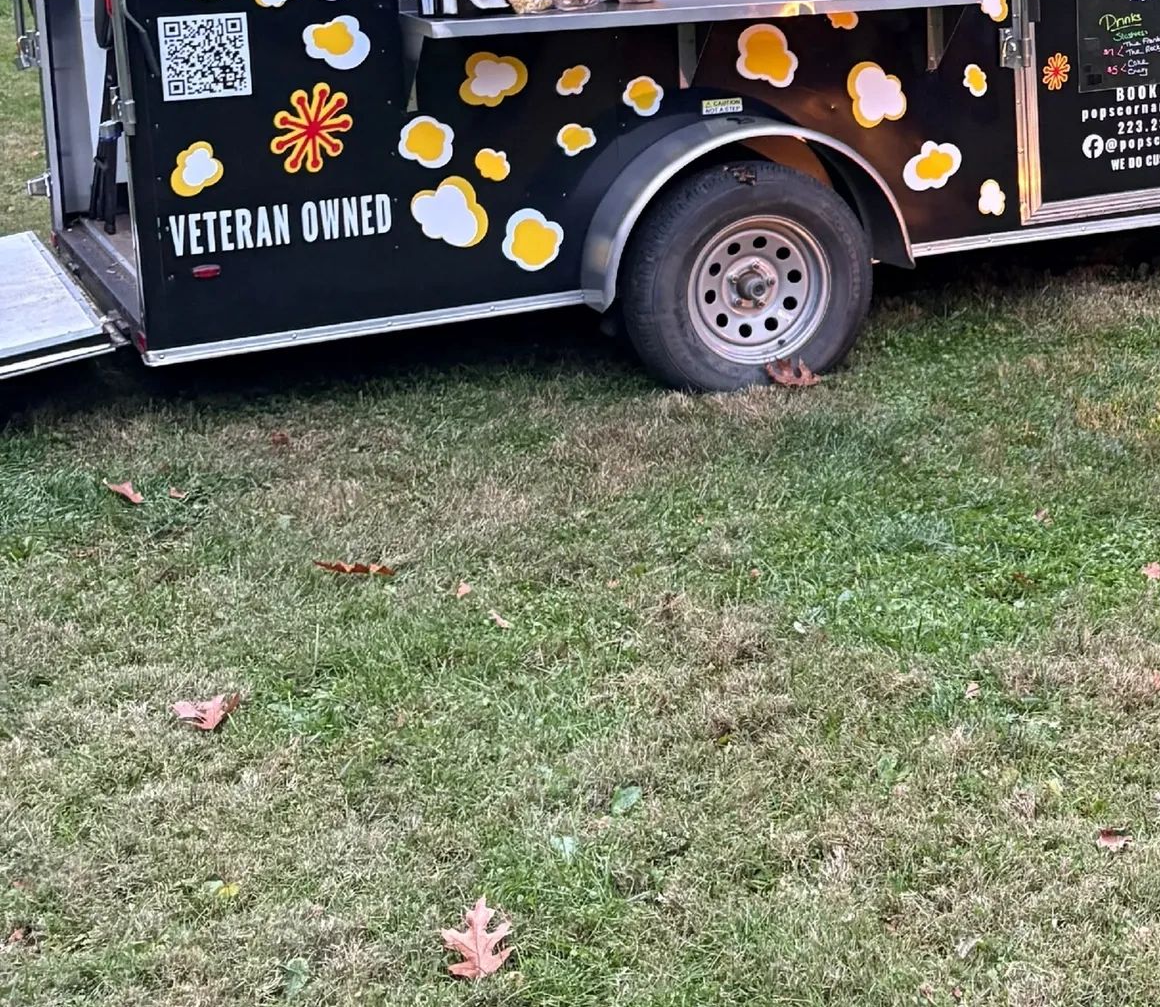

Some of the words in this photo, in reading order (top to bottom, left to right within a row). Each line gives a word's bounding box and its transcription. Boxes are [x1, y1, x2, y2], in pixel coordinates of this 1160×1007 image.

[1099, 13, 1142, 30] Drinks
[1116, 84, 1157, 102] BOOK
[1111, 157, 1125, 171] WE
[1128, 156, 1142, 169] DO
[168, 203, 291, 257] VETERAN
[301, 193, 393, 243] OWNED
